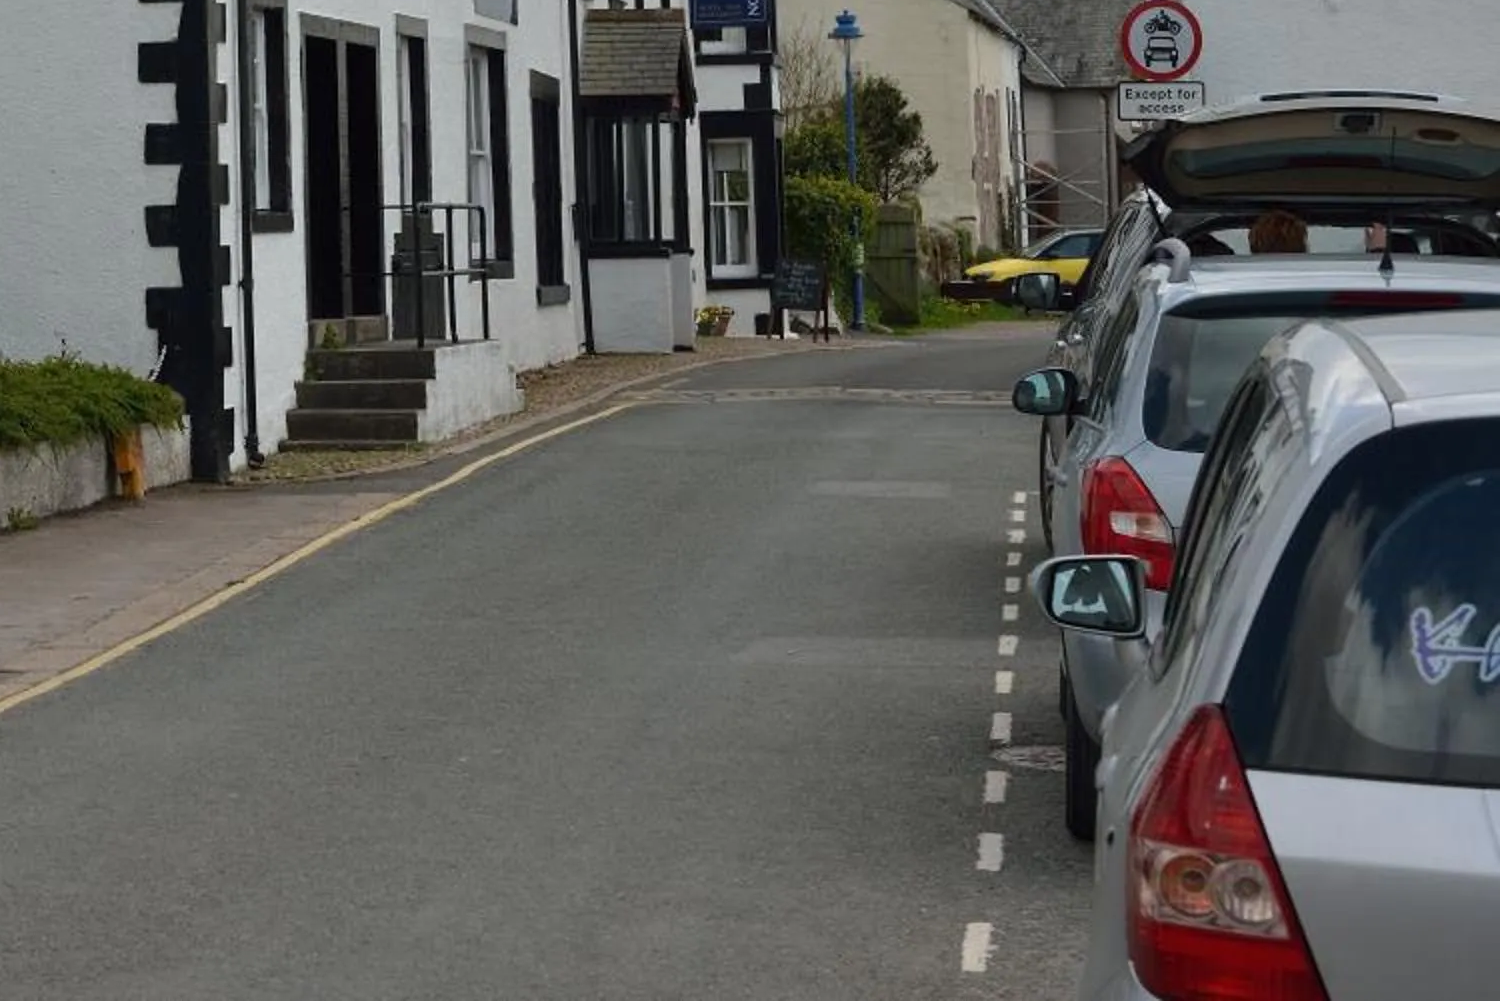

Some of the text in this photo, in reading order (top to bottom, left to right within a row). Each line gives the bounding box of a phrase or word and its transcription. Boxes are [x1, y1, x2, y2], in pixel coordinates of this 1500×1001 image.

[1125, 88, 1197, 101] Except for
[1139, 104, 1185, 114] access
